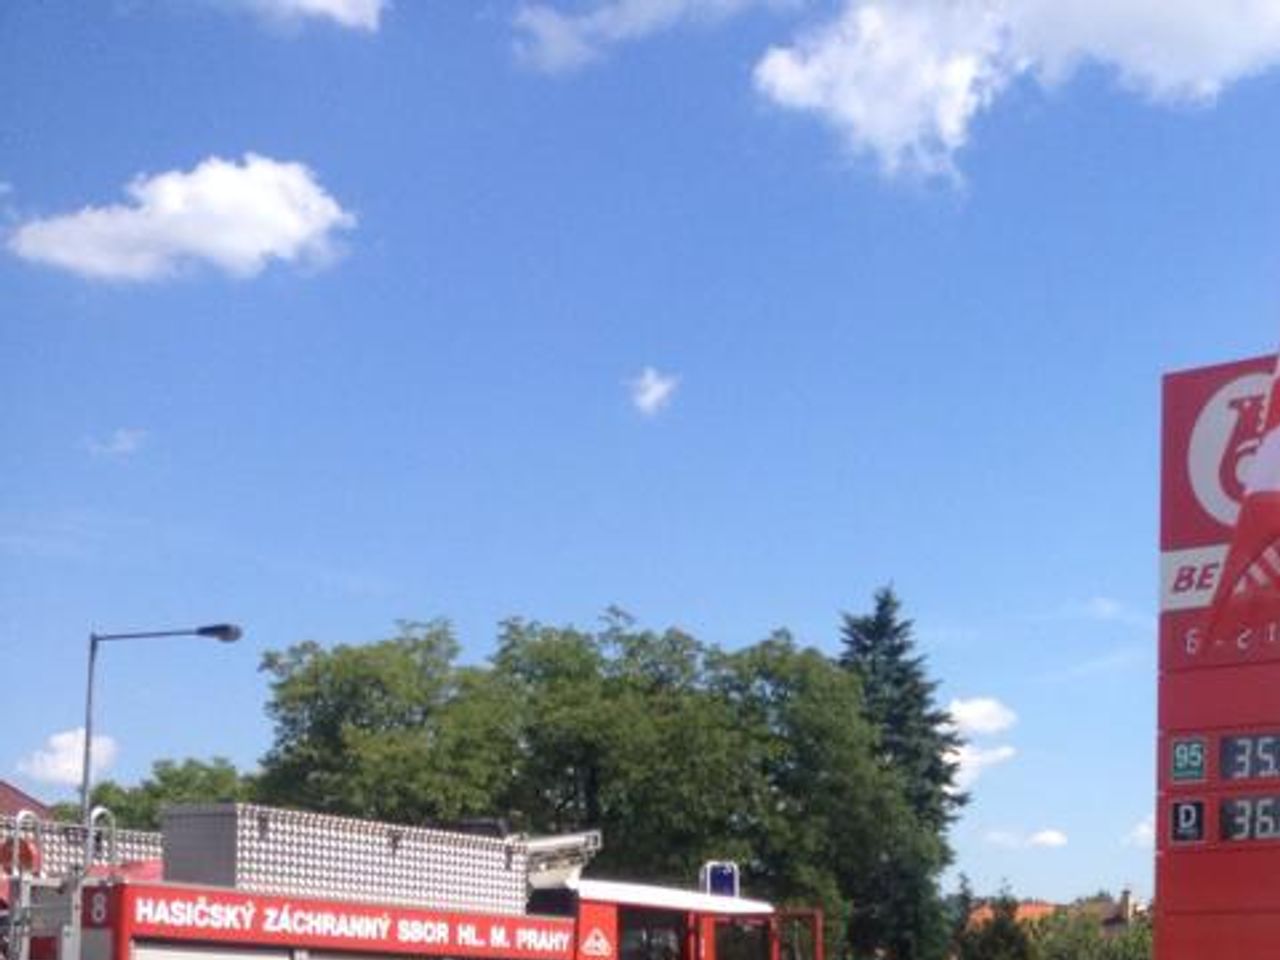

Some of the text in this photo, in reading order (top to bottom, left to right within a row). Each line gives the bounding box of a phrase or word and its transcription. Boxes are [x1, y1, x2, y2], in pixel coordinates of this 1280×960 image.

[1175, 743, 1202, 769] 95
[1178, 804, 1197, 828] D
[134, 896, 256, 930] HASIČSKÝ
[262, 903, 391, 941] ZÁCHRANNÝ
[397, 918, 449, 943] SBOR
[515, 926, 570, 952] PRAHY
